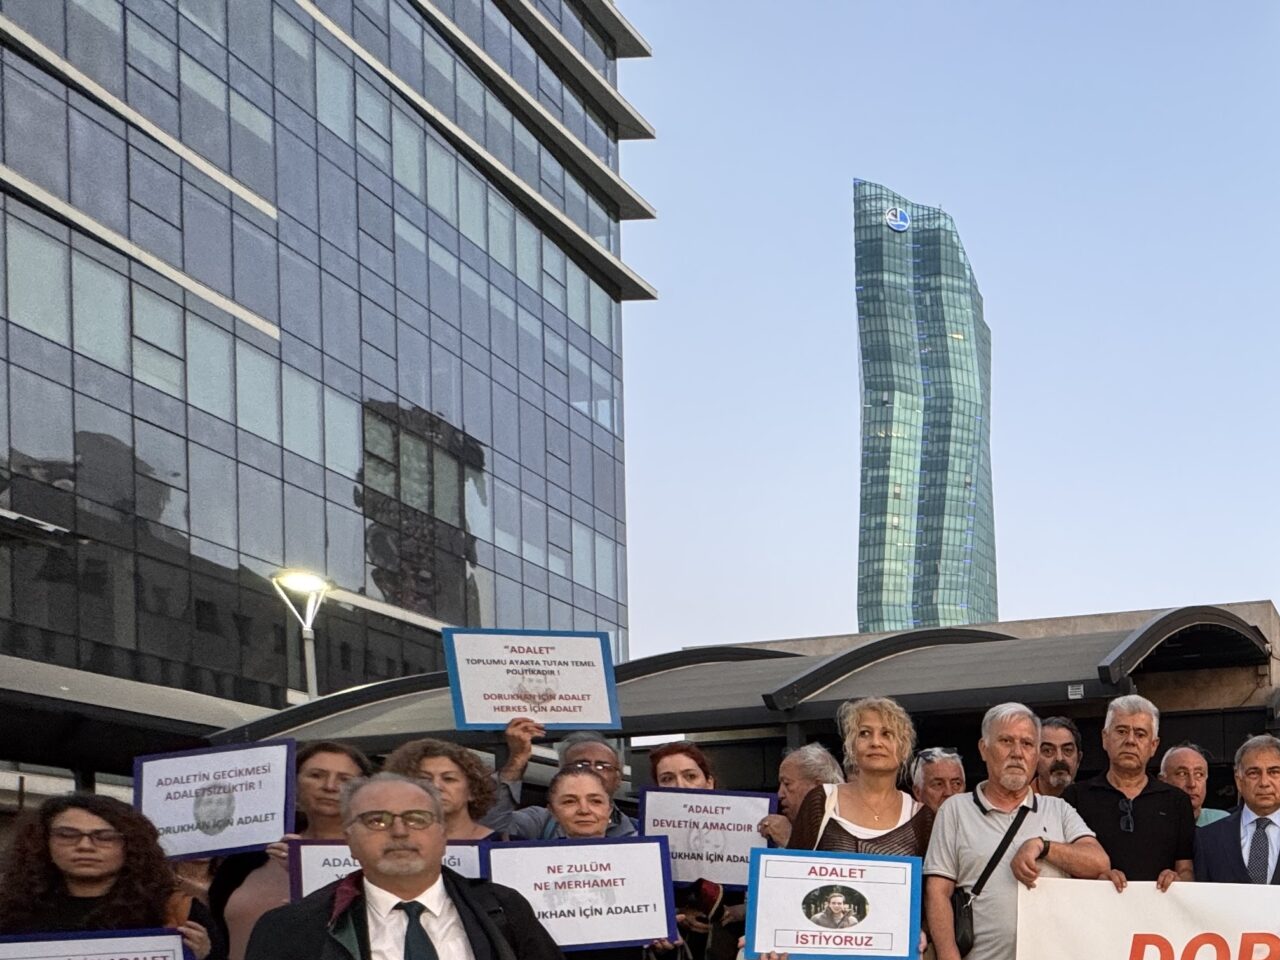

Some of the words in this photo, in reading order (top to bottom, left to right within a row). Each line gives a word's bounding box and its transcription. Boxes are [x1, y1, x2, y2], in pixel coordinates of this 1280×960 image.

[466, 658, 507, 666] TOPLUMU
[509, 659, 541, 667] AYAKTA
[571, 660, 596, 668] TEMEL
[506, 667, 555, 676] POLİTİKADIR
[483, 693, 537, 701] DORUKHAN
[538, 692, 556, 702] İÇİN
[493, 705, 528, 713] HERKES
[530, 704, 548, 714] İÇİN
[550, 705, 582, 713] ADALET
[156, 772, 210, 788] ADALETİN
[213, 763, 271, 781] GECİKMESİ
[165, 781, 256, 801] ADALETSİZLİKTİR
[158, 821, 210, 836] ORUKHAN
[236, 812, 276, 826] ADALET
[652, 819, 699, 829] DEVLETİN
[702, 821, 753, 832] AMACIDIR
[322, 857, 360, 867] ADAL
[671, 852, 703, 861] UKHAN
[706, 852, 724, 864] İÇİN
[726, 854, 750, 863] ADAL
[546, 864, 563, 874] NE
[567, 862, 611, 873] ZULÜM
[807, 866, 867, 879] ADALET
[533, 882, 550, 891] NE
[554, 877, 626, 890] MERHAMET
[535, 909, 576, 920] UKHAN
[579, 906, 603, 919] İÇİN
[606, 904, 650, 915] ADALET
[795, 931, 873, 947] İSTİYORUZ
